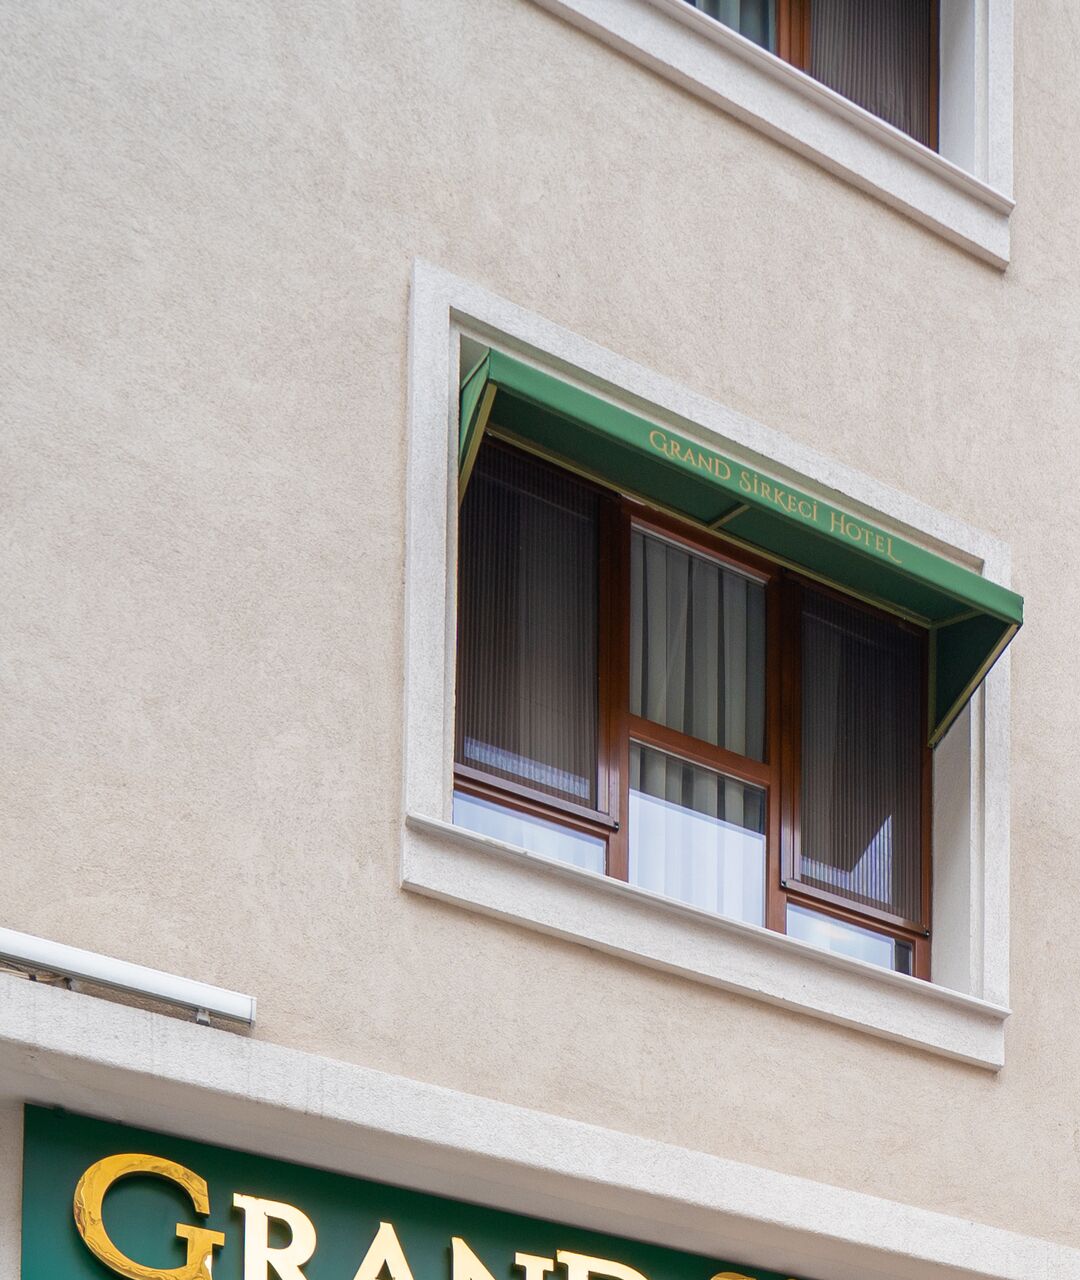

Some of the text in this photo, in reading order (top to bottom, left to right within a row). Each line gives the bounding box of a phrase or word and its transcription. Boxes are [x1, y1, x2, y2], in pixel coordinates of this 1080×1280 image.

[650, 430, 903, 564] GRAND SİRKECİ HOTEL
